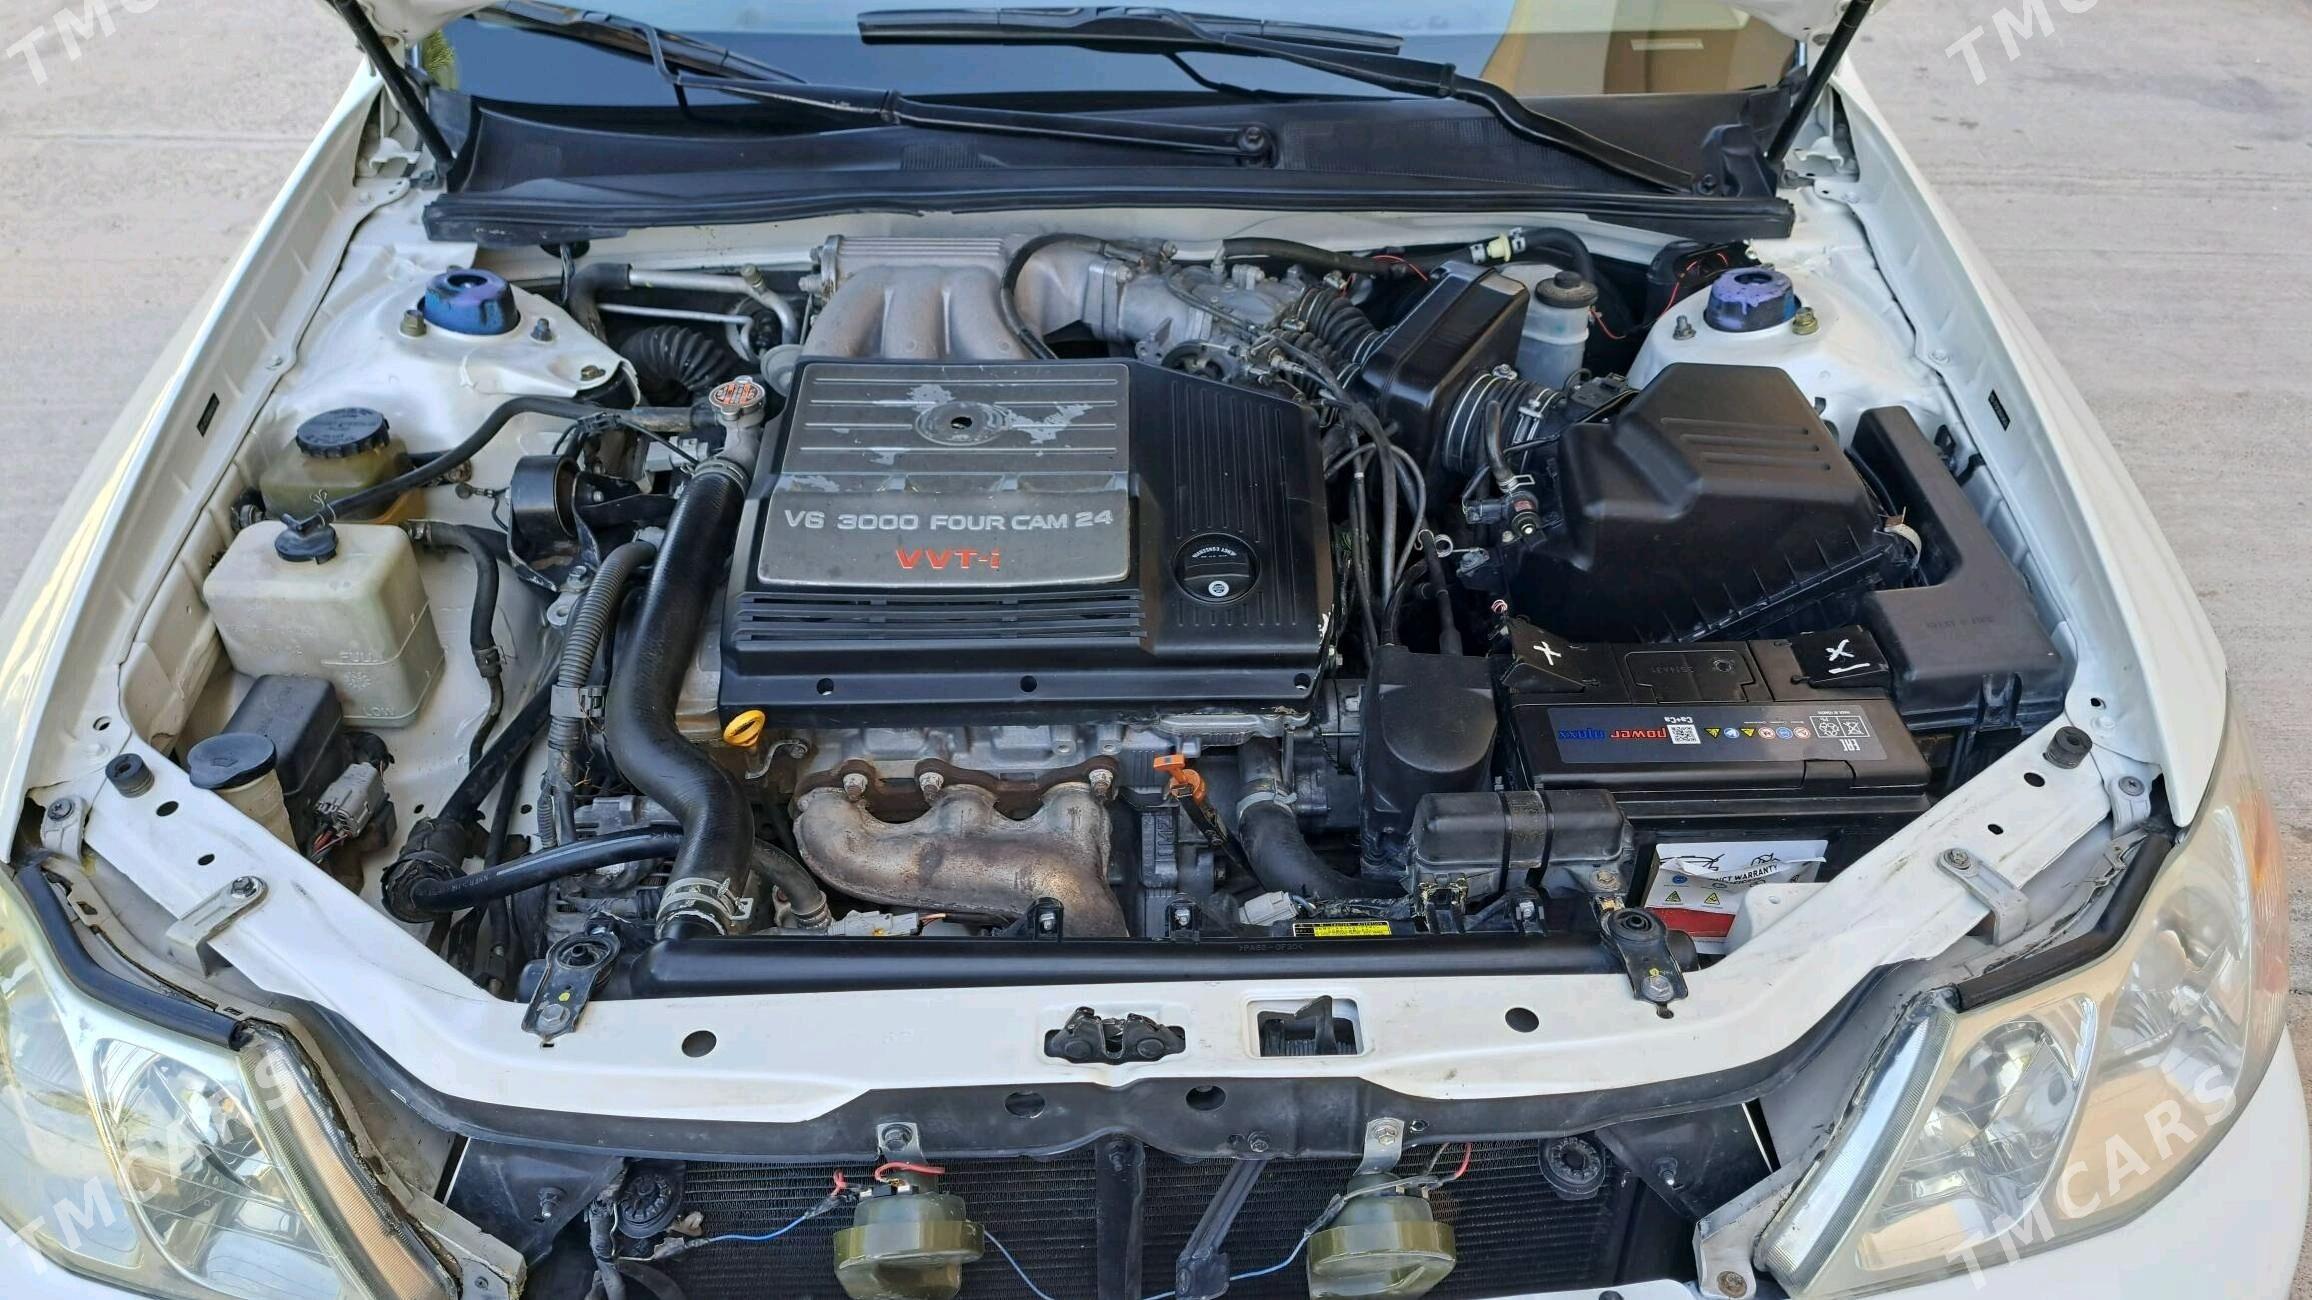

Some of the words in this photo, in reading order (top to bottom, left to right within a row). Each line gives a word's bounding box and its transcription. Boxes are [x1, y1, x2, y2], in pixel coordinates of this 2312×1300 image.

[784, 509, 825, 529] V6
[837, 513, 919, 530] 3000
[930, 513, 1006, 530] FOUR
[1011, 513, 1068, 530] CAM
[1075, 509, 1114, 528] 24
[895, 549, 1001, 569] VVT-i
[1664, 716, 1694, 724] Ca+Ca
[1610, 728, 1668, 740] power
[1734, 863, 1779, 882] WARRANTY
